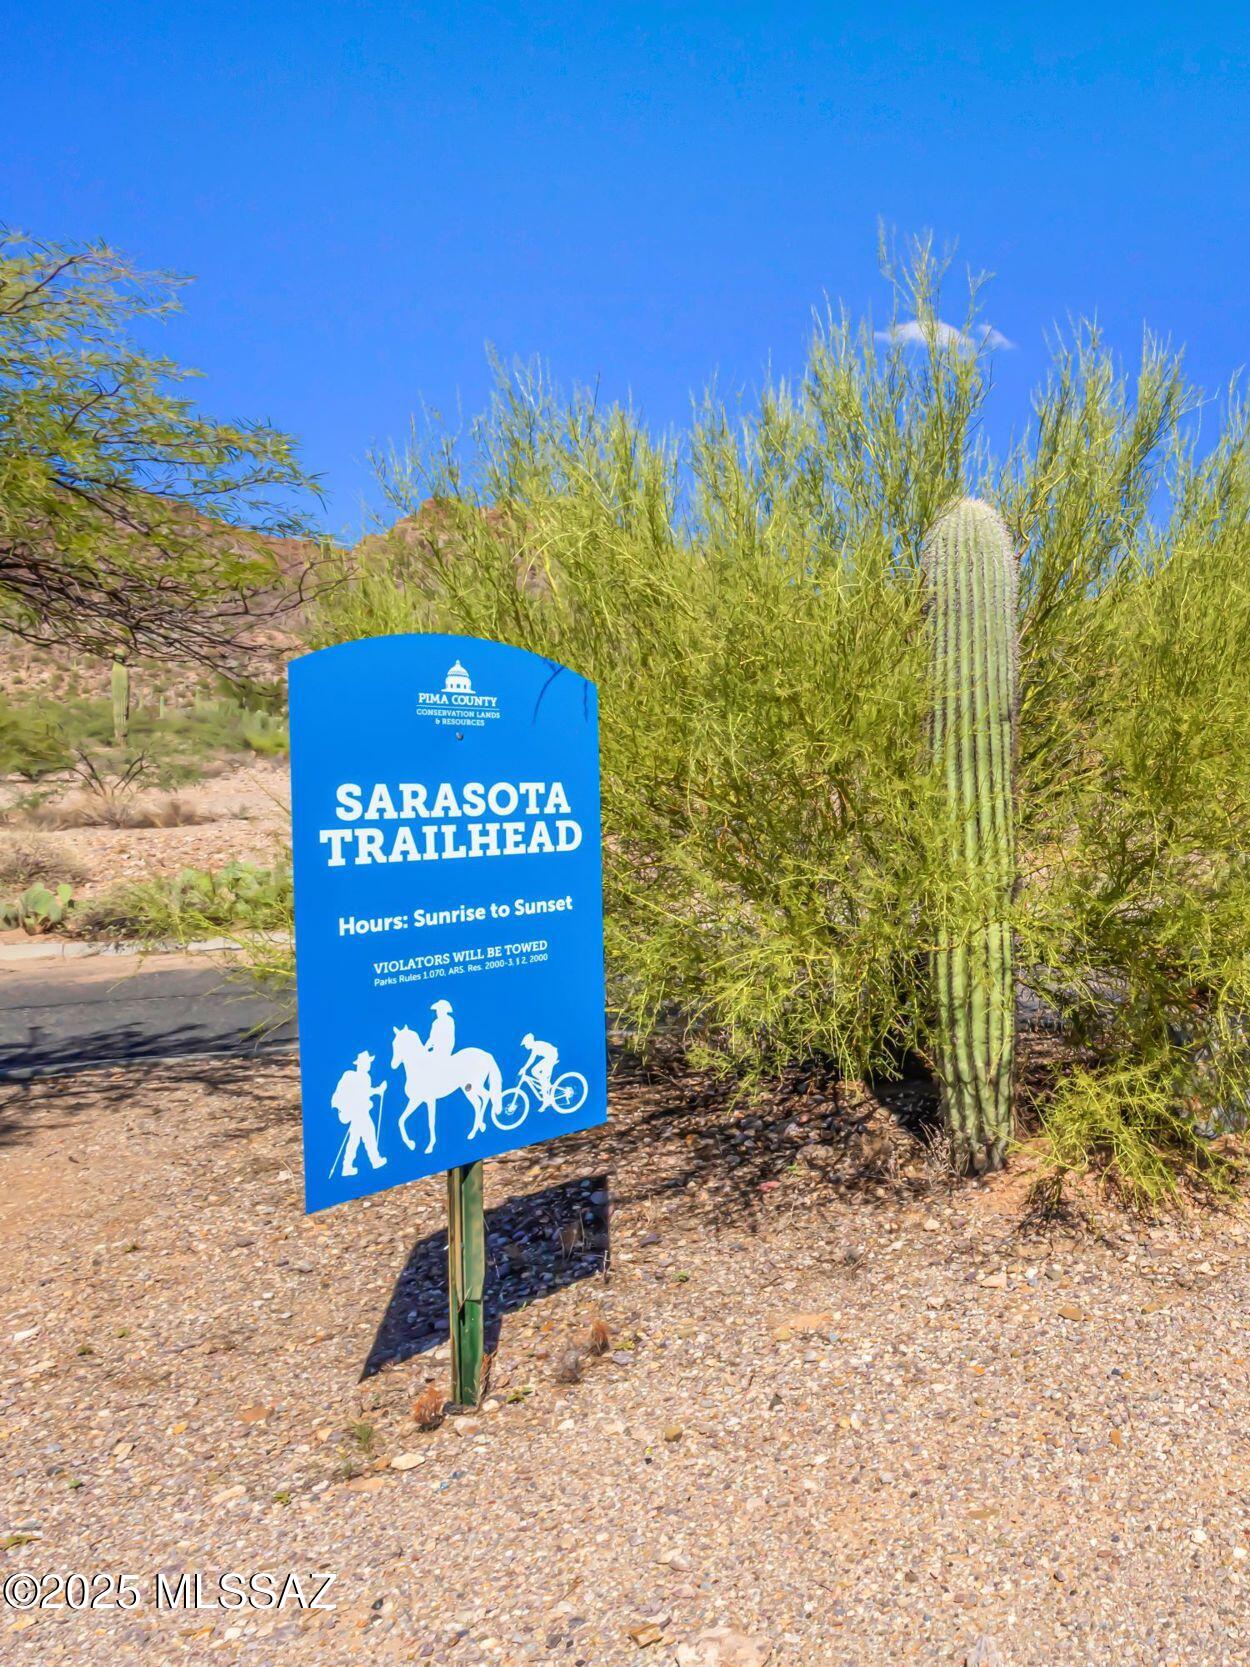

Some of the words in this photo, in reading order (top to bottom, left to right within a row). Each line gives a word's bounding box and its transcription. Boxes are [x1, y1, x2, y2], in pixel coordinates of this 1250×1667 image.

[416, 708, 475, 718] CONSERVATION
[476, 711, 501, 719] LANDS
[418, 692, 449, 704] PIMA
[451, 695, 498, 707] COUNTY
[335, 781, 572, 822] SARASOTA
[319, 819, 583, 867] TRAILHEAD
[338, 915, 409, 936] Hours:
[413, 904, 486, 928] Sunrise
[490, 902, 511, 919] to
[514, 895, 573, 916] Sunset
[373, 953, 450, 974] VIOLATORS
[452, 949, 485, 963] WILL
[487, 946, 503, 958] BE
[504, 940, 548, 955] TOWED
[374, 977, 398, 987] Parks
[399, 973, 422, 983] Rules
[529, 953, 549, 963] 2000
